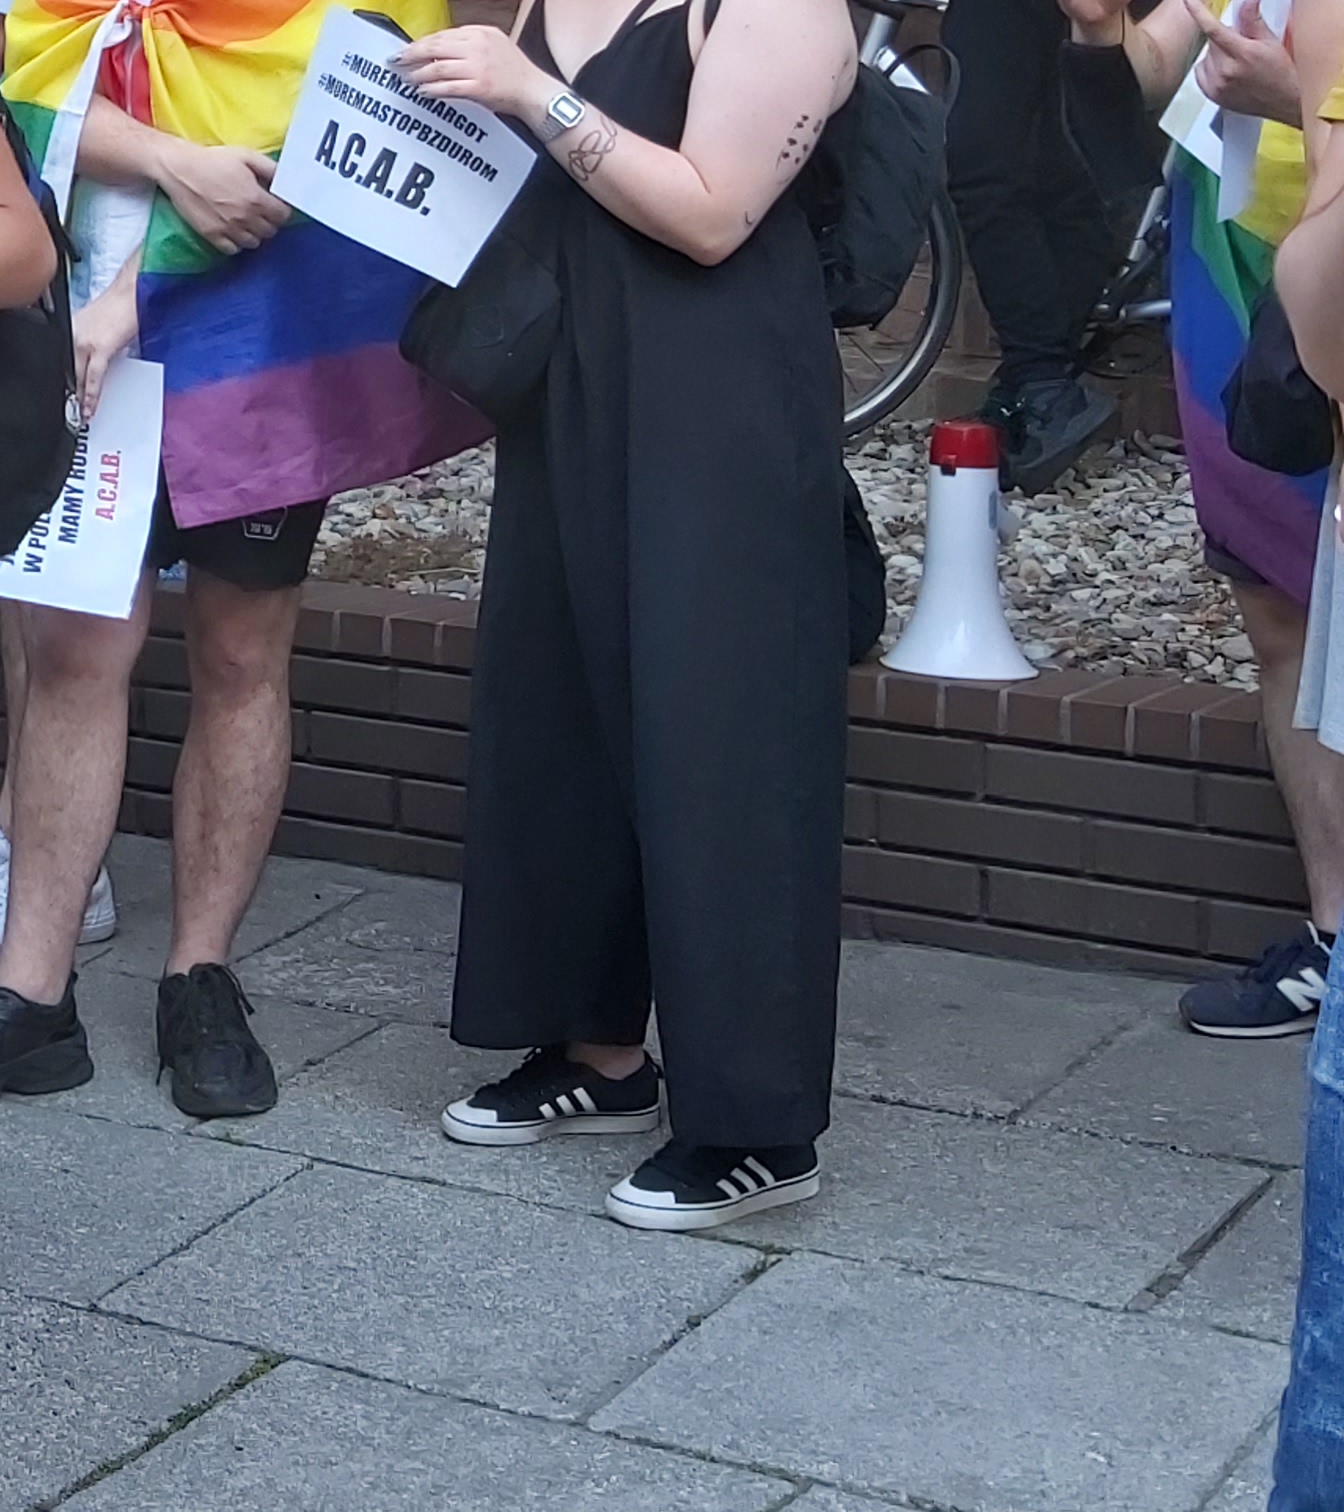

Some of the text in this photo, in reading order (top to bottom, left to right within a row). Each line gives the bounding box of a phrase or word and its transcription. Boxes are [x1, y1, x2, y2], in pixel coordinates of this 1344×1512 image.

[315, 119, 435, 216] A.C.A.B.
[318, 73, 498, 183] #MUREMZASTOPBZDUROM
[58, 484, 85, 544] MAMY
